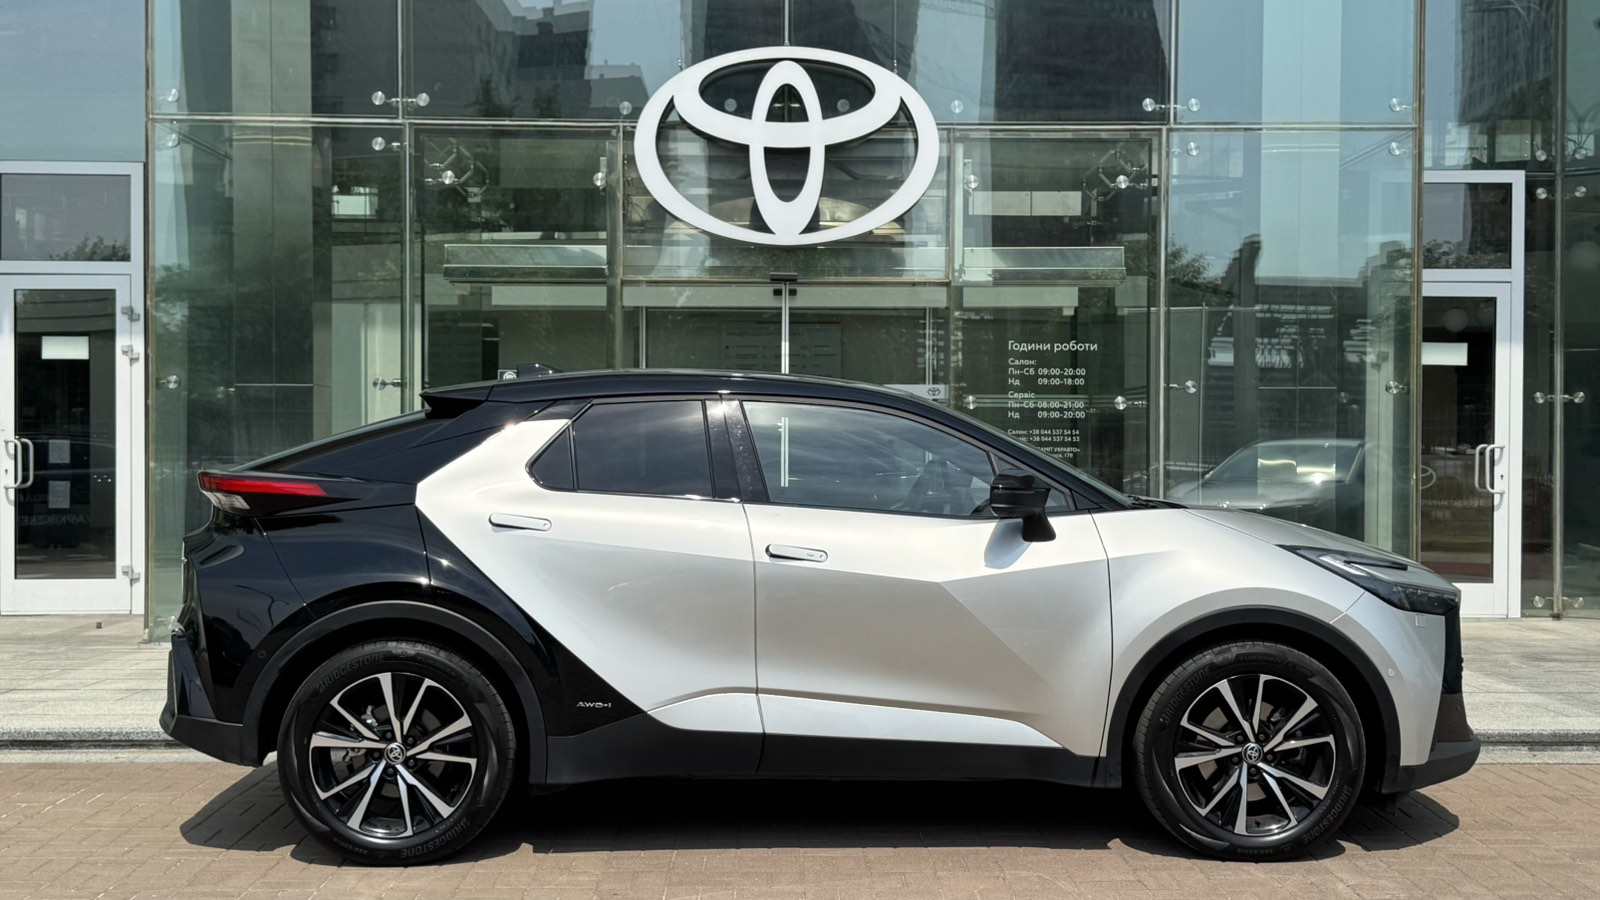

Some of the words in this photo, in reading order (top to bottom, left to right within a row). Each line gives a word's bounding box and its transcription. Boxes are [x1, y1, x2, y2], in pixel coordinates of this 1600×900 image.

[1008, 340, 1051, 352] Години
[1054, 340, 1098, 353] роботи
[1008, 390, 1035, 399] Сервіс
[317, 652, 385, 694] BRIDGESTONE
[1160, 667, 1212, 725] BRIDGESTONE
[1302, 784, 1354, 844] BRIDGESTONE
[400, 818, 472, 858] BRIDGESTONE
